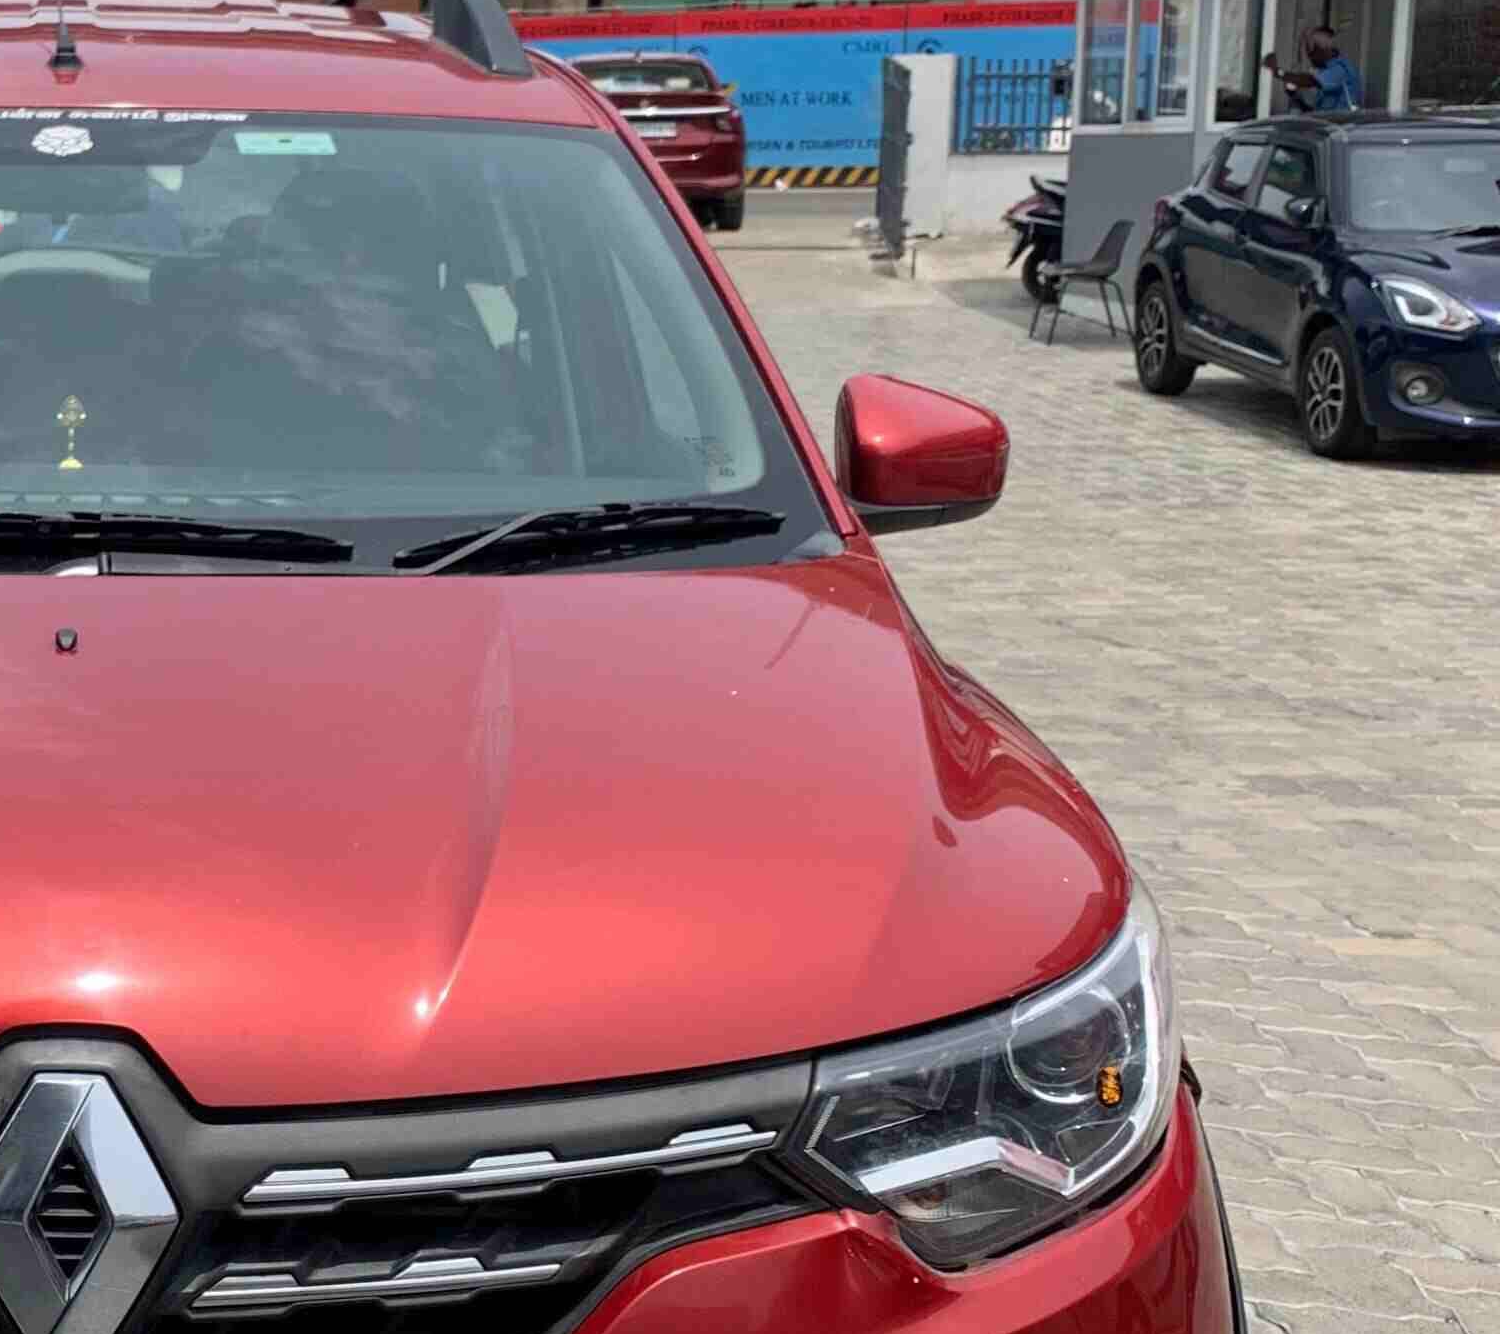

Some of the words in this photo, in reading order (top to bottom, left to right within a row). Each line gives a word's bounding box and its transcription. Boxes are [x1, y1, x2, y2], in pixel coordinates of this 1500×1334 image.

[740, 91, 776, 107] MEN
[779, 91, 801, 107] AT
[804, 90, 853, 107] WORK
